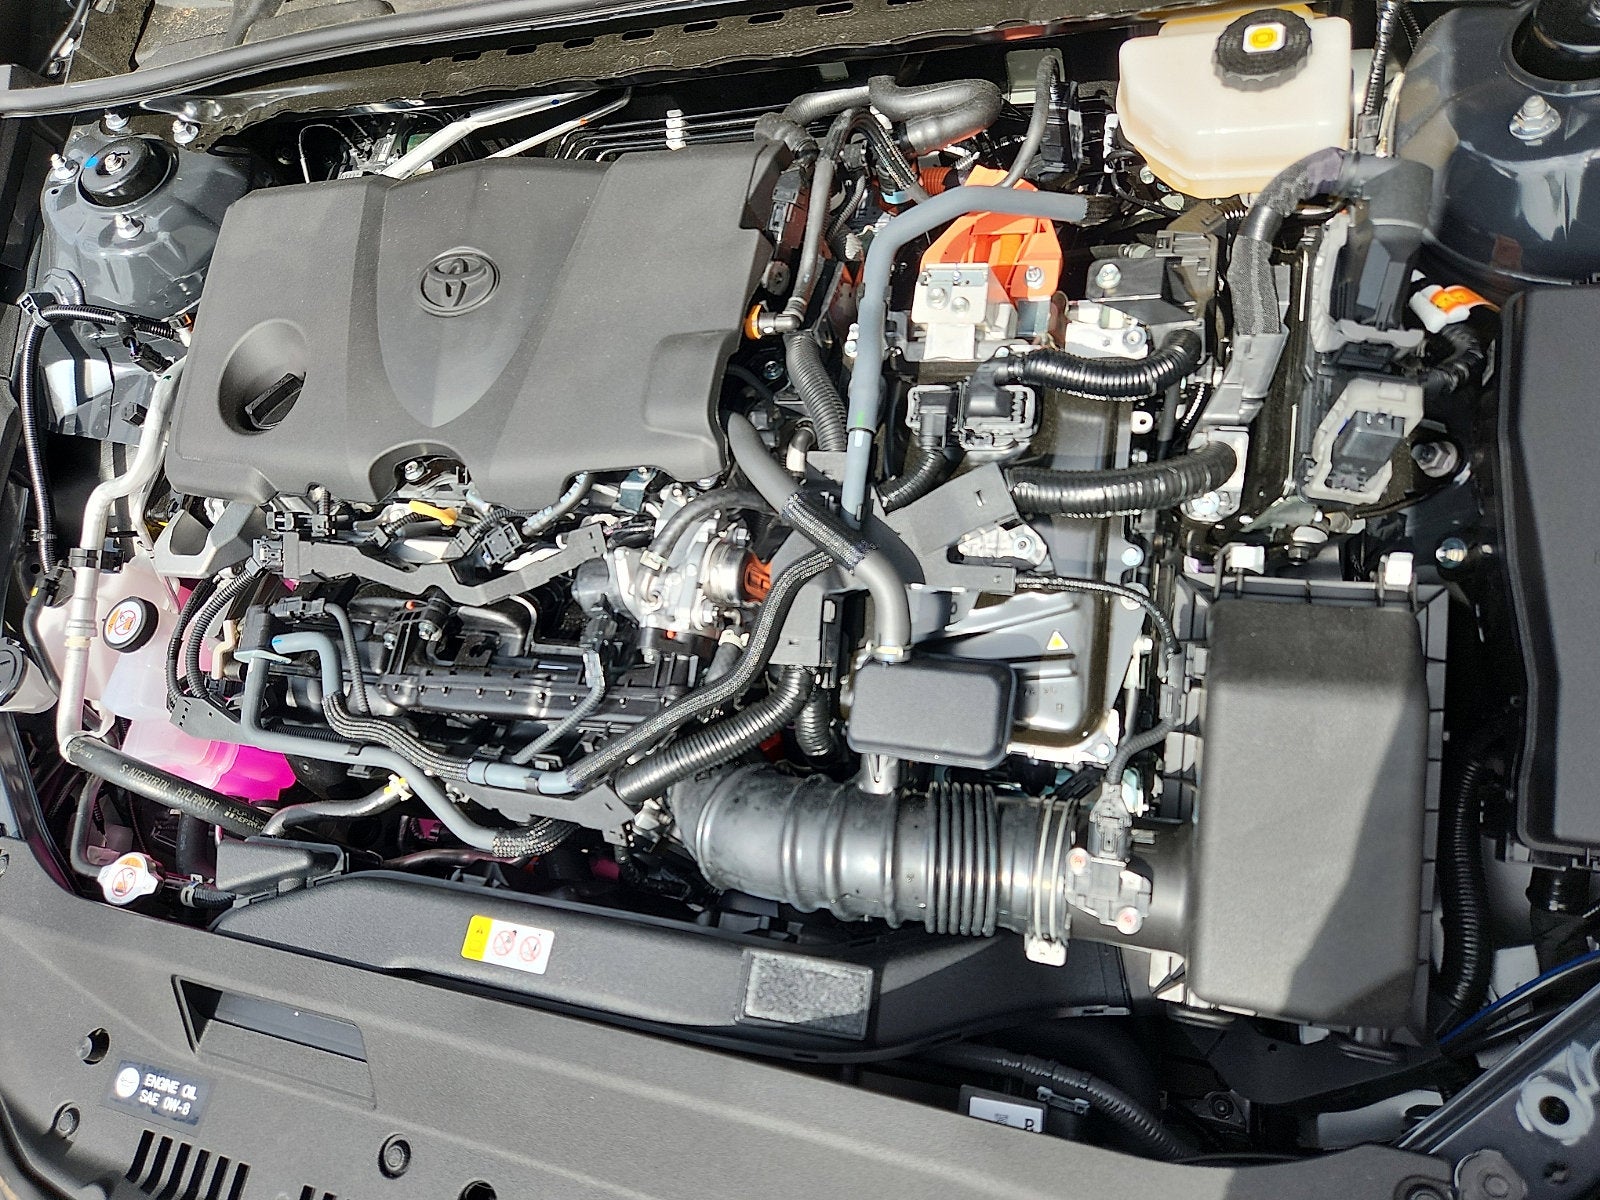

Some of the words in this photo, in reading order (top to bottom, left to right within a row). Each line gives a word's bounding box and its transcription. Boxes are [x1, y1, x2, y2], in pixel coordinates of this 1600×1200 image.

[139, 1089, 160, 1106] SAE
[143, 1073, 180, 1095] ENGINE
[181, 1084, 198, 1101] OIL
